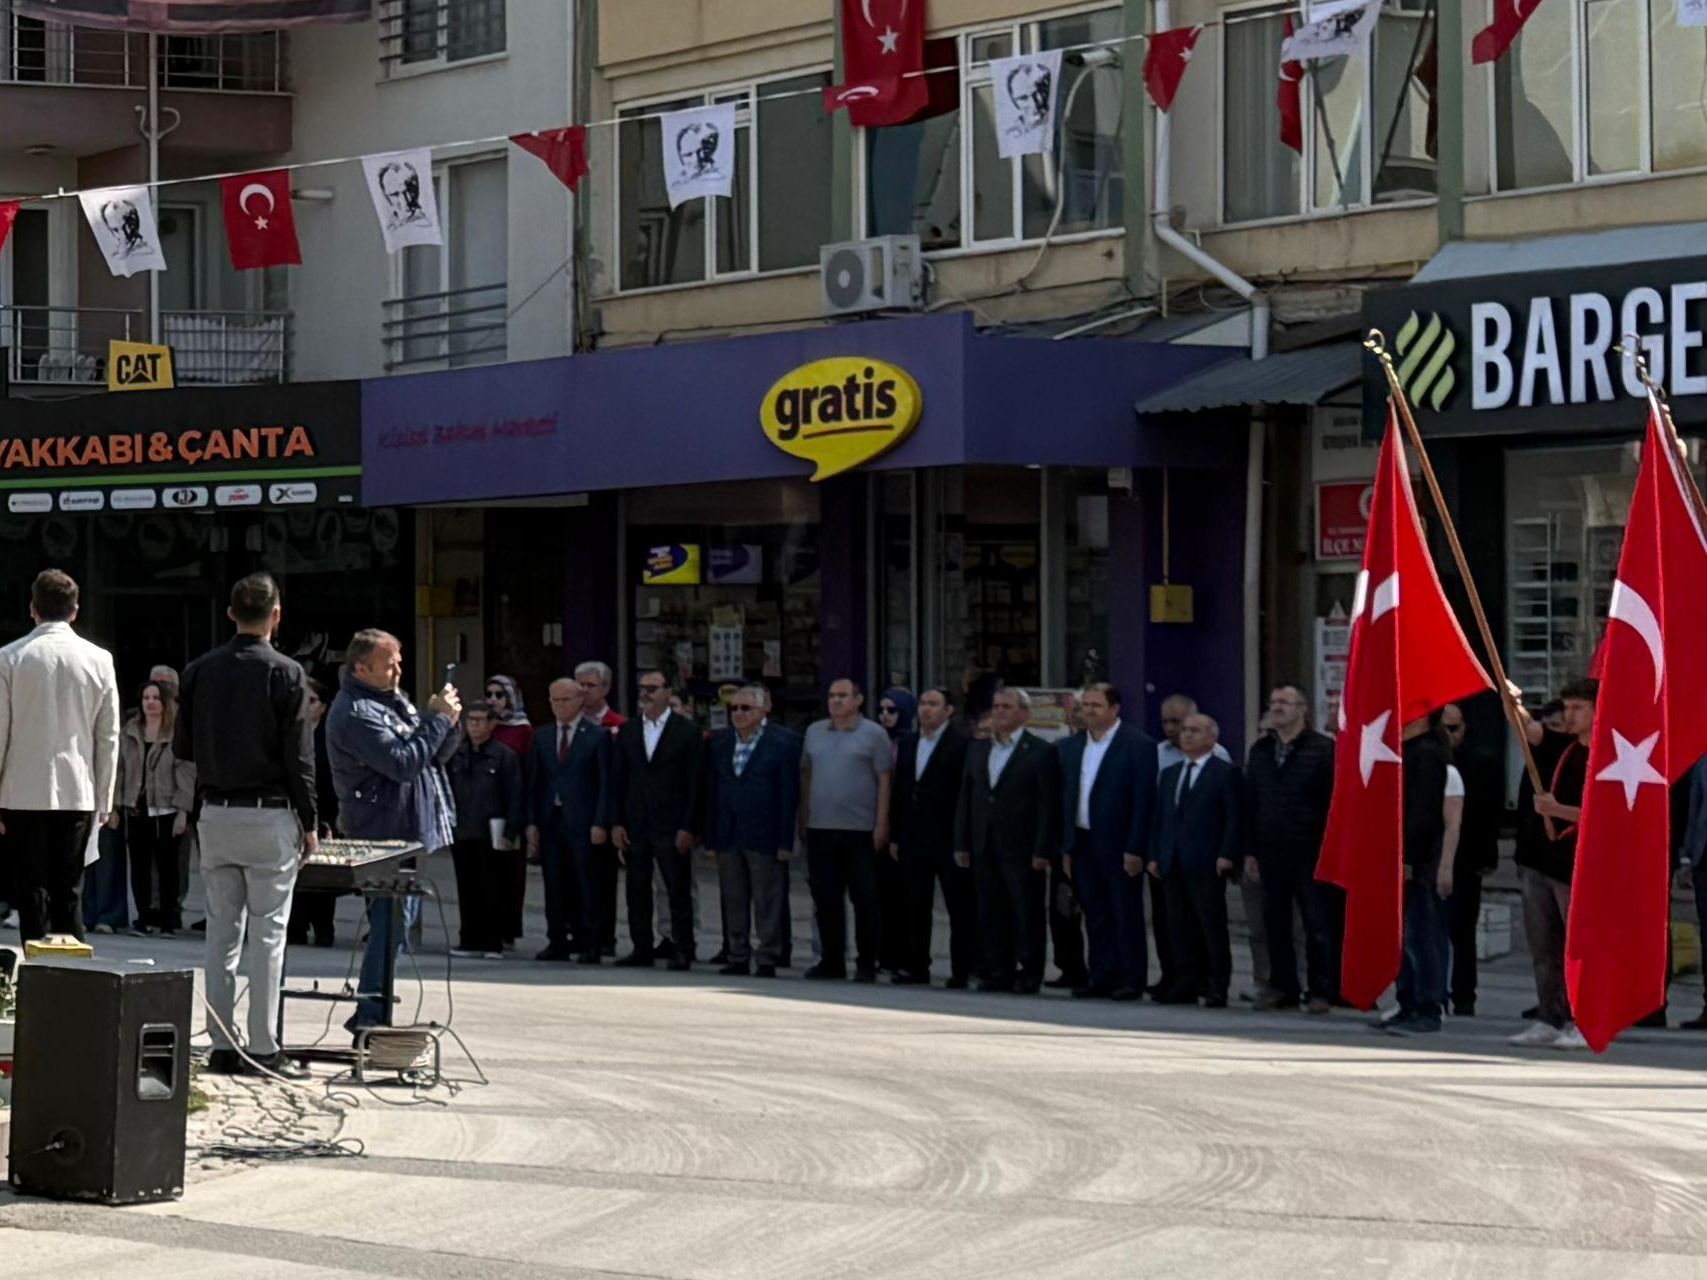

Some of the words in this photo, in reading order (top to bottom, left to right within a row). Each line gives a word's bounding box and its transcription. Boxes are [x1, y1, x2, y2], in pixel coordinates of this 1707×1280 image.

[117, 353, 162, 385] CAT
[1471, 282, 1707, 410] BARGE
[775, 366, 897, 441] gratis
[147, 433, 174, 463] &
[177, 426, 314, 466] ÇANTA
